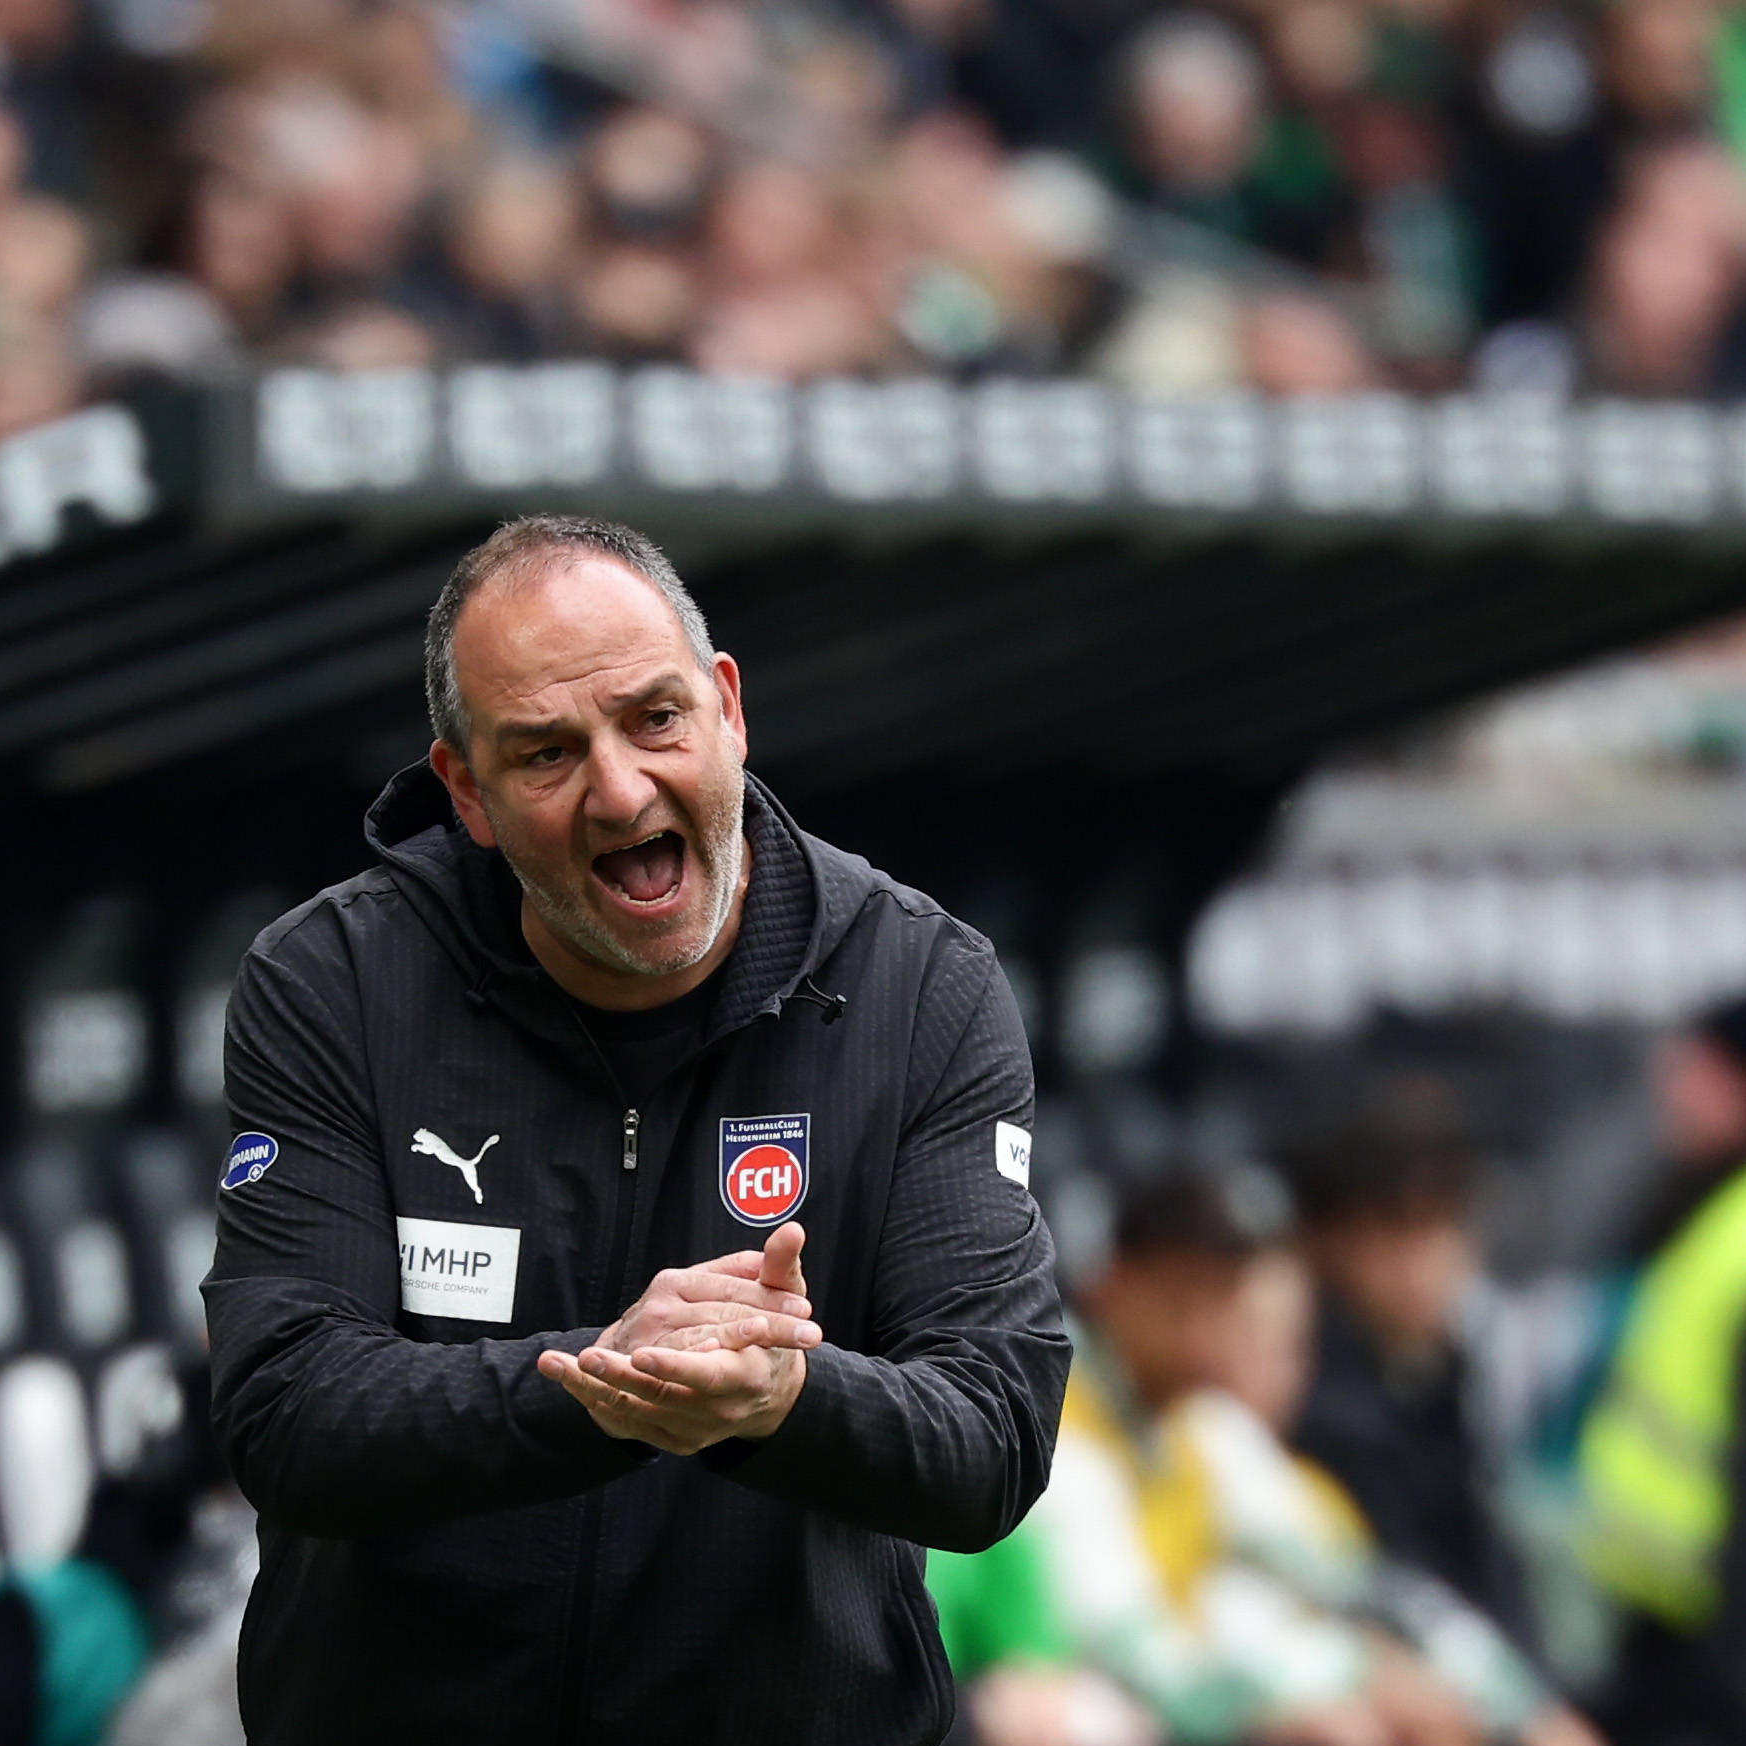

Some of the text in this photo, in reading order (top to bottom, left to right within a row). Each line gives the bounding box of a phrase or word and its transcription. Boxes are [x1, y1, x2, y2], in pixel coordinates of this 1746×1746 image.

[725, 1129, 804, 1143] HEIDENHEIM 1846
[738, 1165, 793, 1200] FCH
[421, 1246, 492, 1278] MHP
[443, 1283, 490, 1296] COMPANY
